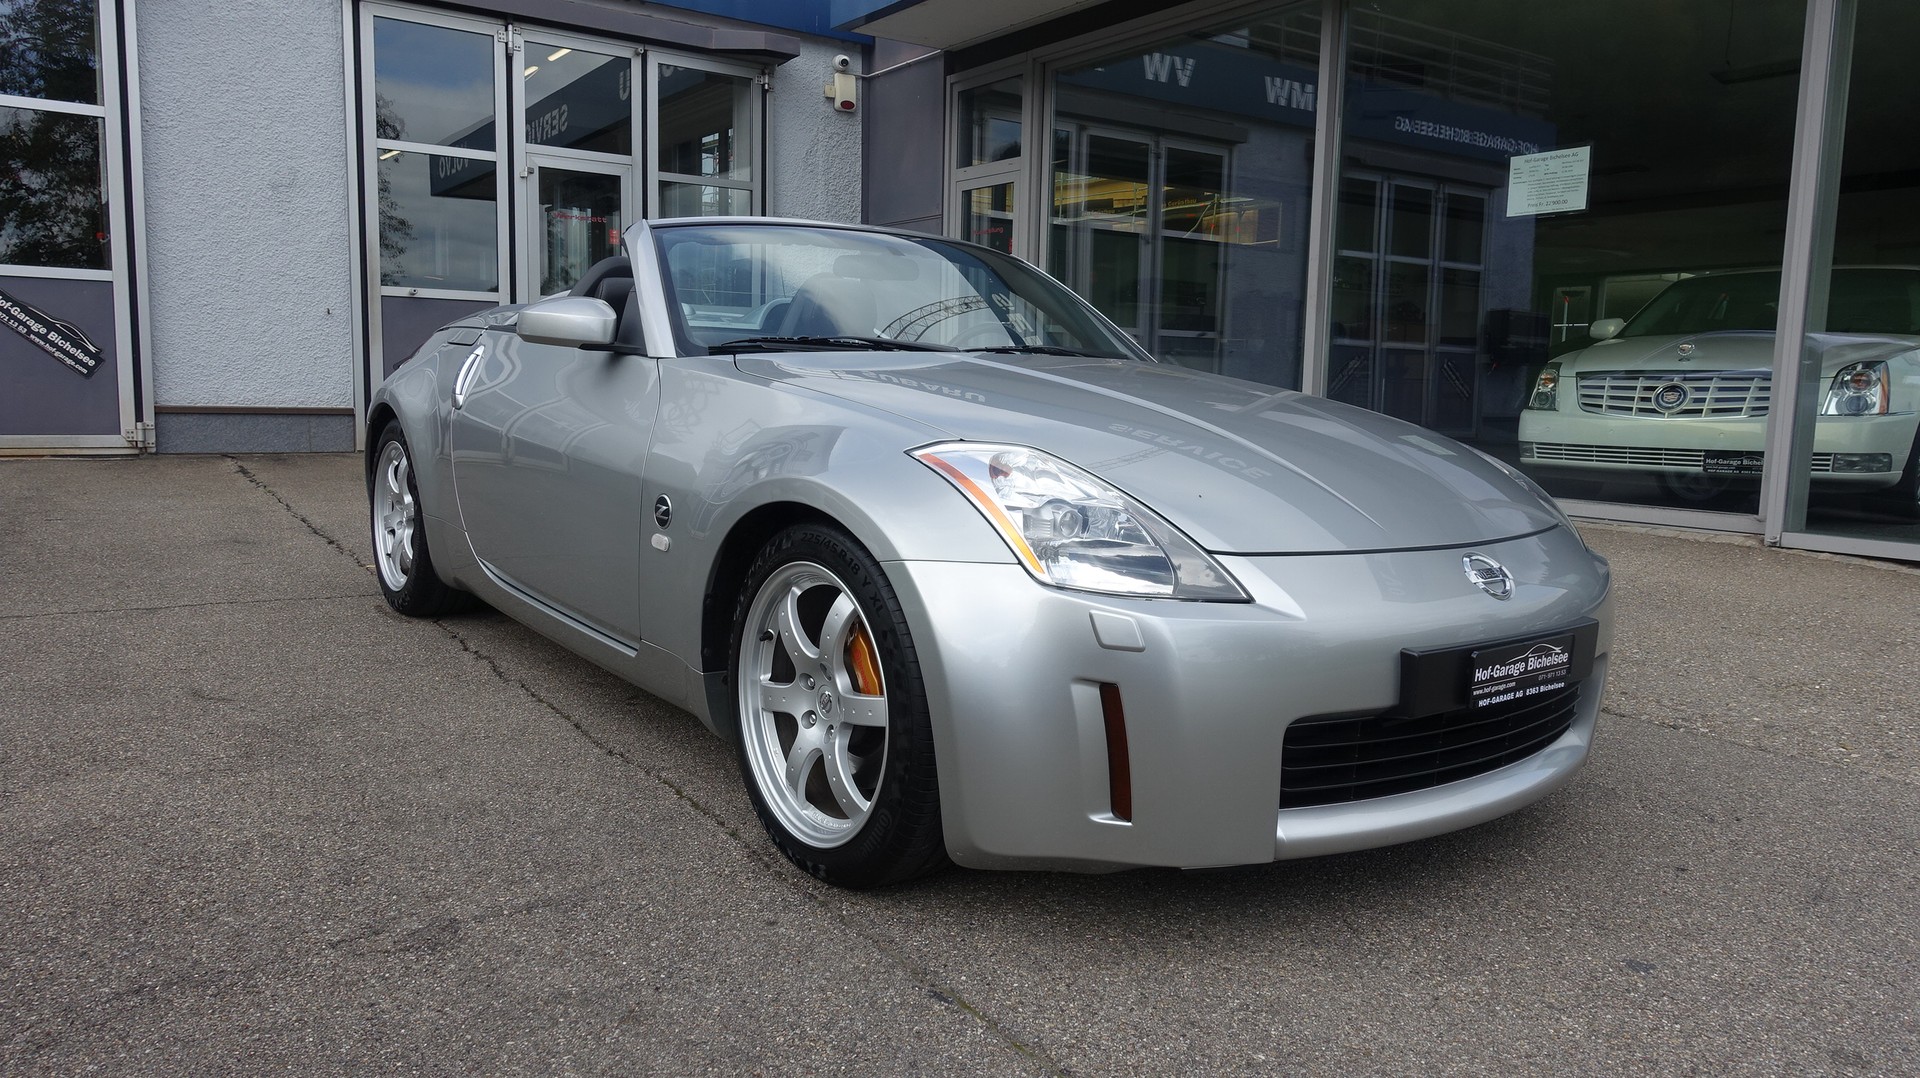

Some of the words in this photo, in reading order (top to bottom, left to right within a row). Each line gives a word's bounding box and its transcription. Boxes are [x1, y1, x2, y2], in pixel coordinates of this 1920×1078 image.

[47, 331, 96, 367] Bichelsee
[801, 532, 839, 554] 225/45
[1475, 662, 1526, 681] Hof-Garage
[1527, 653, 1569, 670] Bichelsee
[1473, 682, 1516, 695] www.hof-garage.com
[1478, 693, 1515, 707] HOF-GARAGE
[1515, 690, 1524, 699] AG
[1540, 682, 1565, 693] Bichelsee
